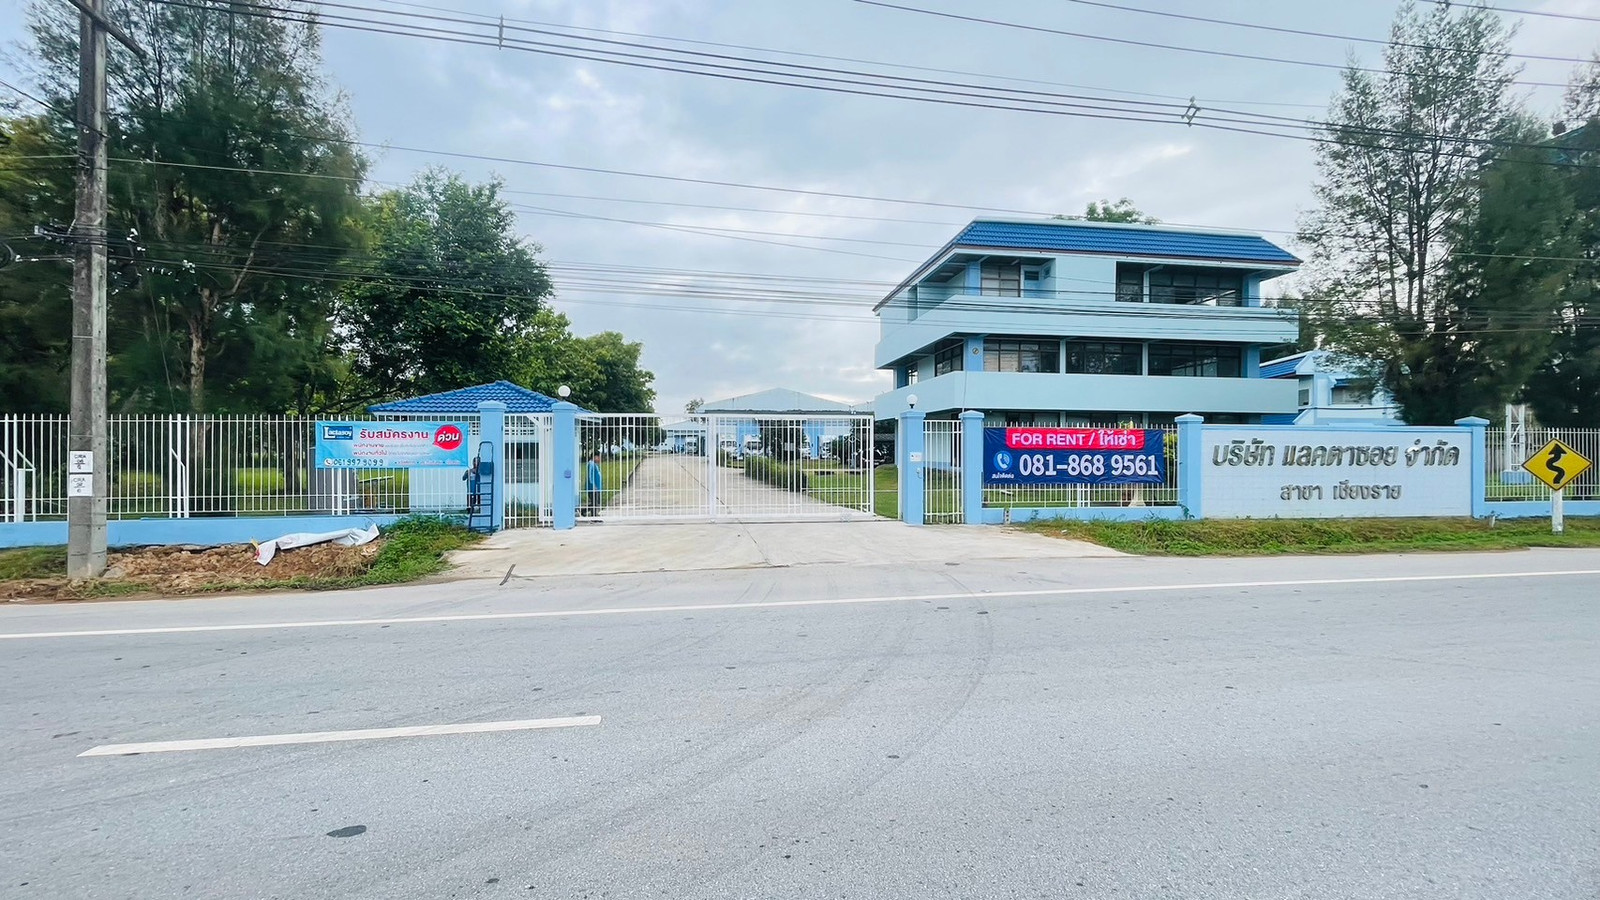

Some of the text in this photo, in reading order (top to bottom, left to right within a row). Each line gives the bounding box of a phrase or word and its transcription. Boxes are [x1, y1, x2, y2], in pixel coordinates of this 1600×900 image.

[324, 426, 352, 439] Lactasoy
[360, 428, 429, 439] รับสมัครงาน
[437, 430, 460, 442] ด่วน
[1012, 429, 1136, 446] FOR RENT / ให้เช่า
[1212, 438, 1460, 467] บริษัท แลคตาซอย จำกัด
[1019, 454, 1159, 476] 081-868 9561
[1280, 480, 1402, 500] สาขา เชียงราย
